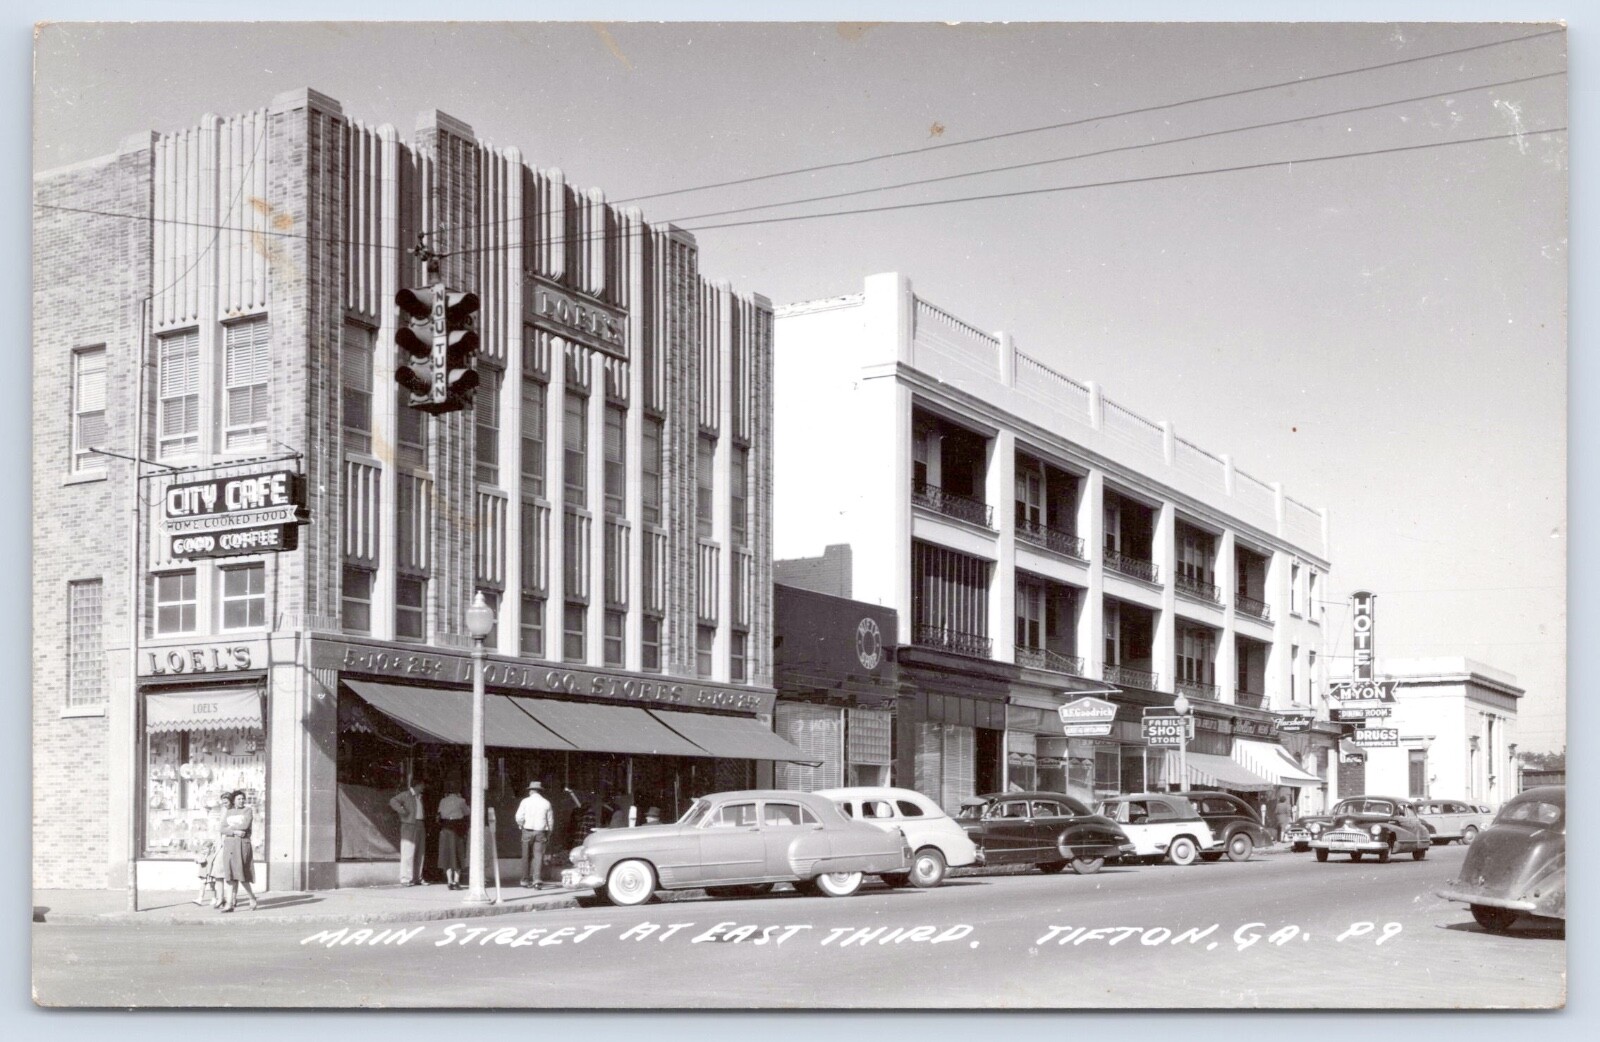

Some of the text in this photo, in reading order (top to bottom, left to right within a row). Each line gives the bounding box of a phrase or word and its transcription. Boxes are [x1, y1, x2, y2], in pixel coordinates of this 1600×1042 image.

[435, 291, 445, 397] NO U TURN
[167, 474, 288, 515] CITY CAFE
[167, 510, 287, 531] HOME COOKED FOOD
[173, 529, 278, 554] GOOD COFFEE
[1354, 598, 1370, 682] HOTEL
[149, 648, 251, 674] LOEL'S
[591, 676, 683, 702] STORES
[1340, 687, 1386, 699] MYON
[193, 703, 218, 714] LOEL'S
[1366, 709, 1387, 717] ROOM
[1356, 730, 1397, 740] DRUGS
